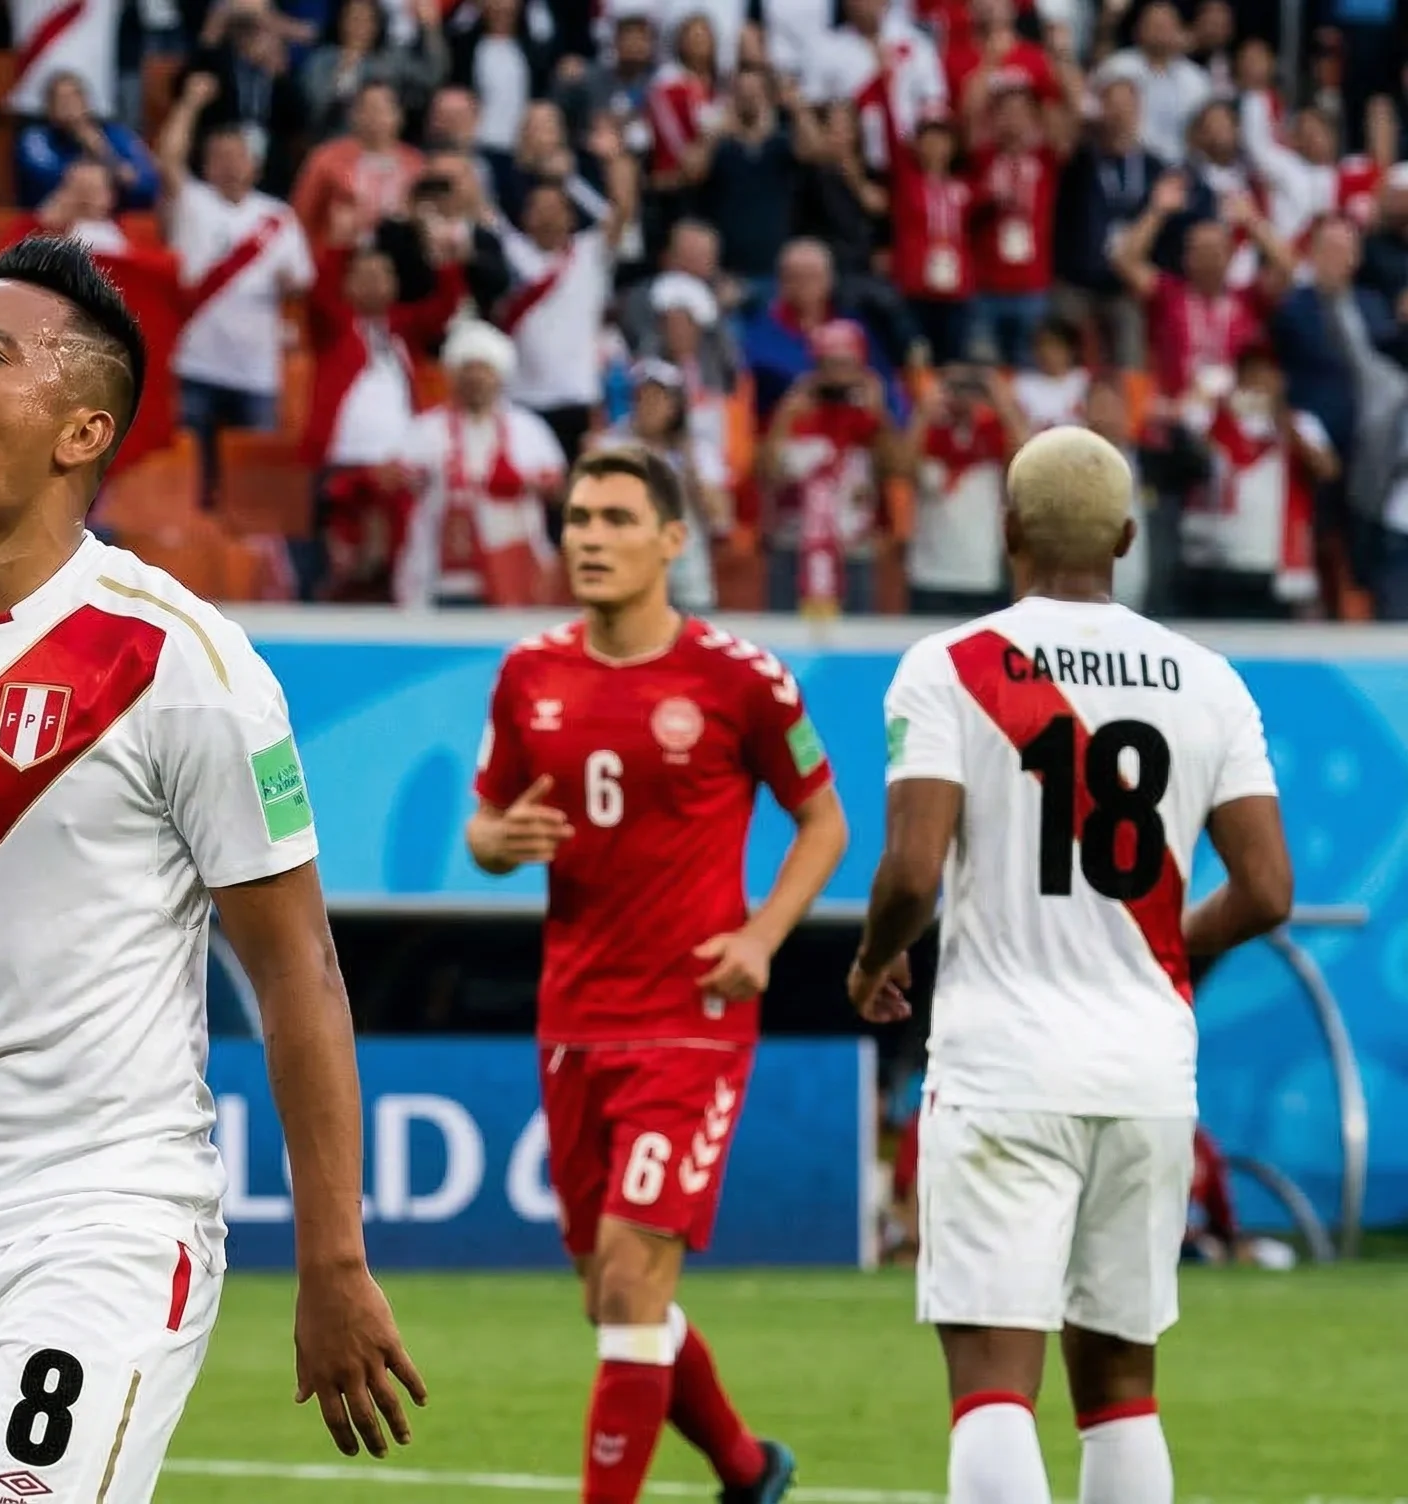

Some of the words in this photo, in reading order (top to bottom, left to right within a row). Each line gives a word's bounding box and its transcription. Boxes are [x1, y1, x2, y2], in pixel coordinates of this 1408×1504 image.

[1001, 643, 1181, 692] CARRILLO
[585, 749, 625, 828] 6
[1020, 712, 1171, 901] 18
[621, 1130, 673, 1206] 6
[5, 1347, 85, 1467] 8
